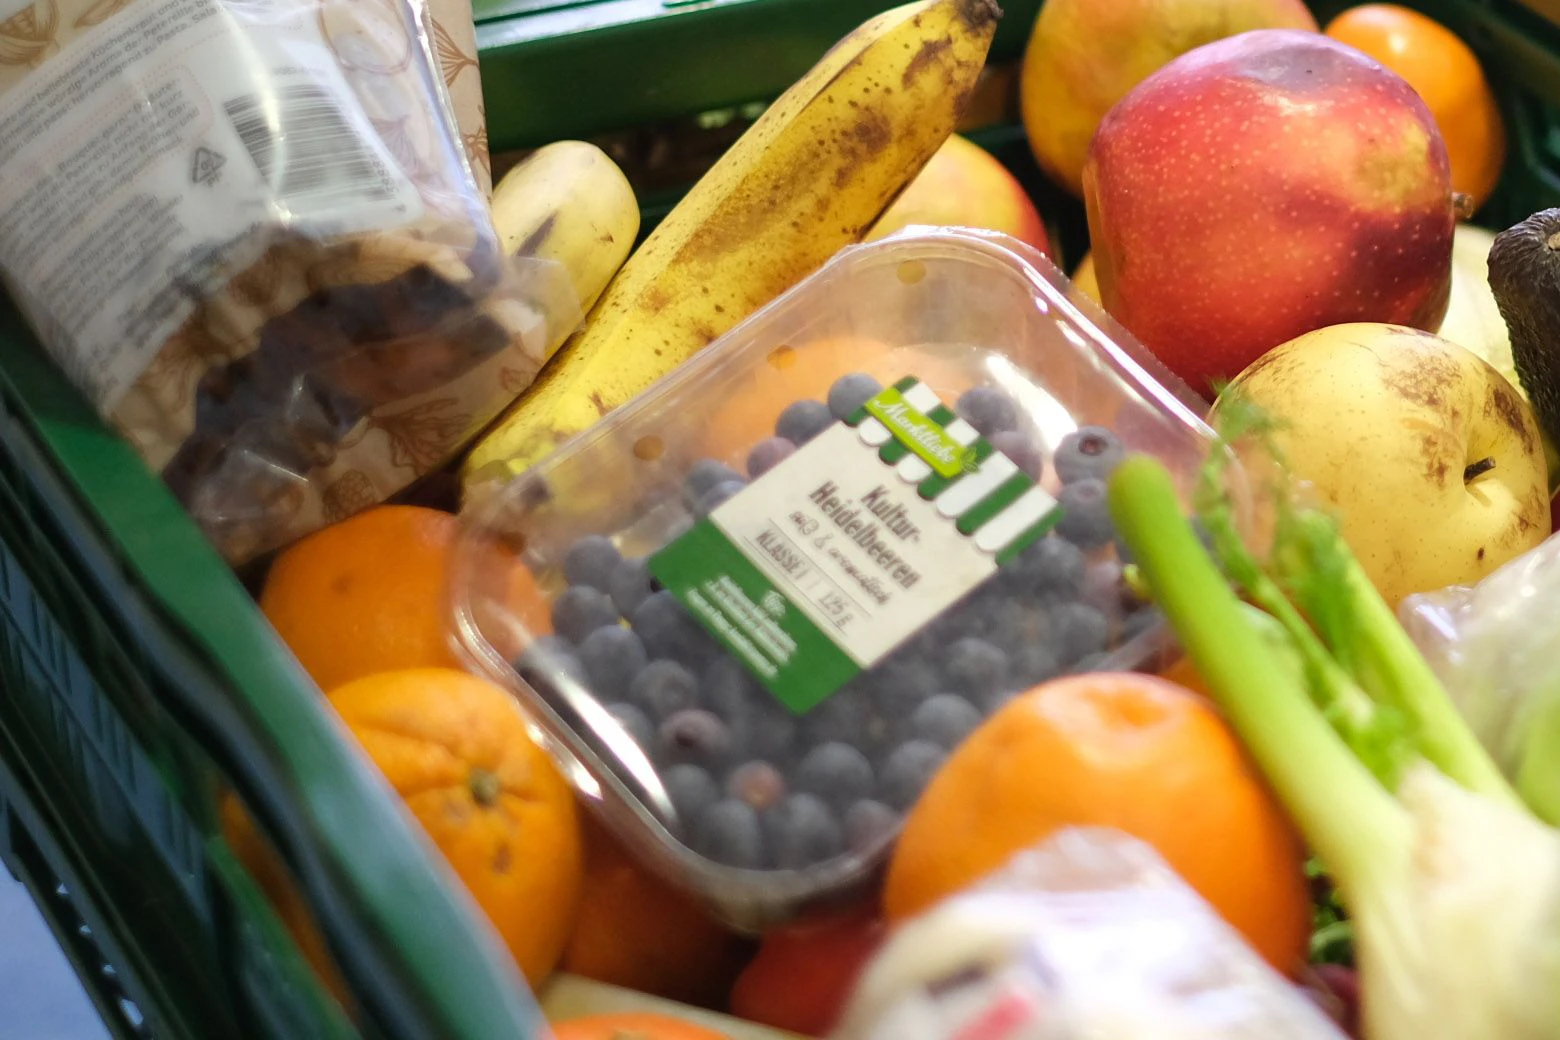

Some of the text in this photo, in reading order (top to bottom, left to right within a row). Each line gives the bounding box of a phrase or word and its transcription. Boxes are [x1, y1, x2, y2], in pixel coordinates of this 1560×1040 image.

[808, 479, 922, 590] Heidelbeeren
[860, 483, 921, 543] Kultur-
[756, 530, 805, 574] KLASSE
[818, 591, 850, 616] 125
